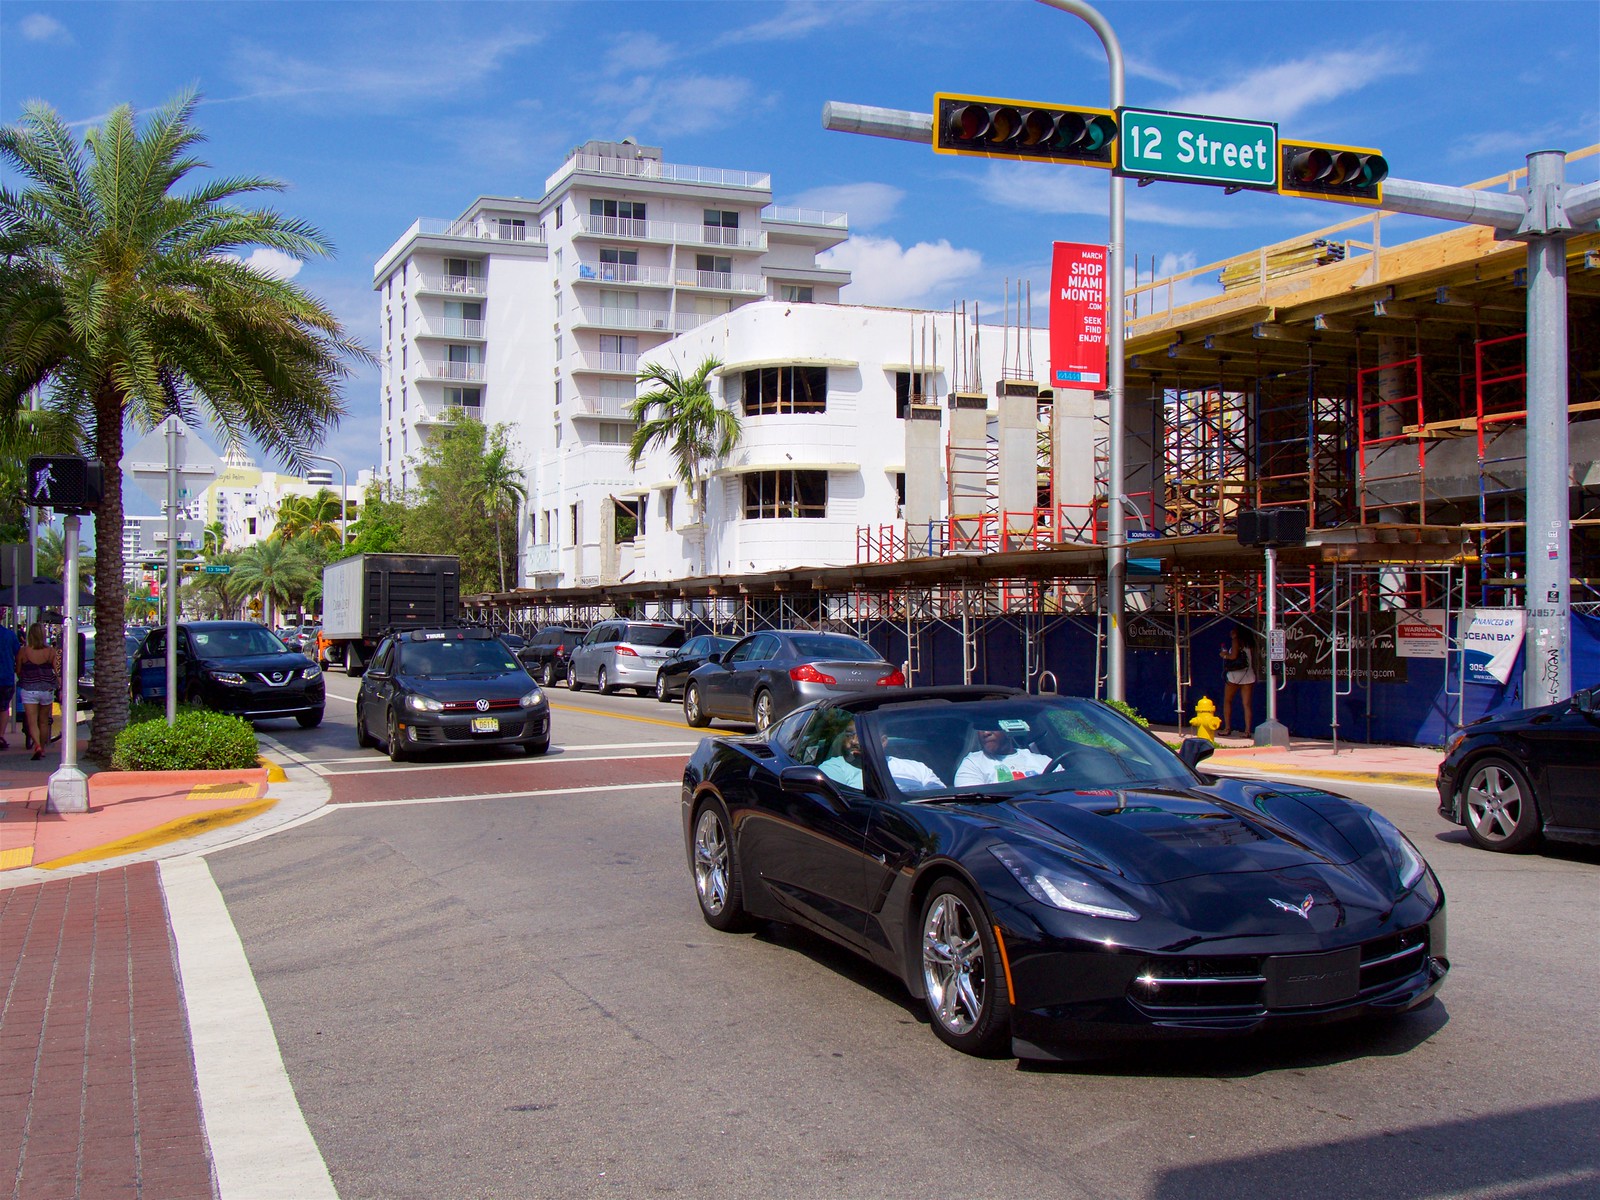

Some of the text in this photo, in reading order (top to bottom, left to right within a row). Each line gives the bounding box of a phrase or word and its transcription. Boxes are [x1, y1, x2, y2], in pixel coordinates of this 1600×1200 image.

[1131, 125, 1267, 170] 12 Street
[1081, 251, 1103, 260] MARCH
[1071, 262, 1103, 276] SHOP
[1068, 275, 1103, 290] MIAMI
[1061, 288, 1103, 303] MONTH
[1087, 302, 1102, 311] .COM
[1083, 316, 1102, 325] SEEK
[1085, 325, 1102, 334] FIND
[1078, 333, 1102, 343] ENJOY
